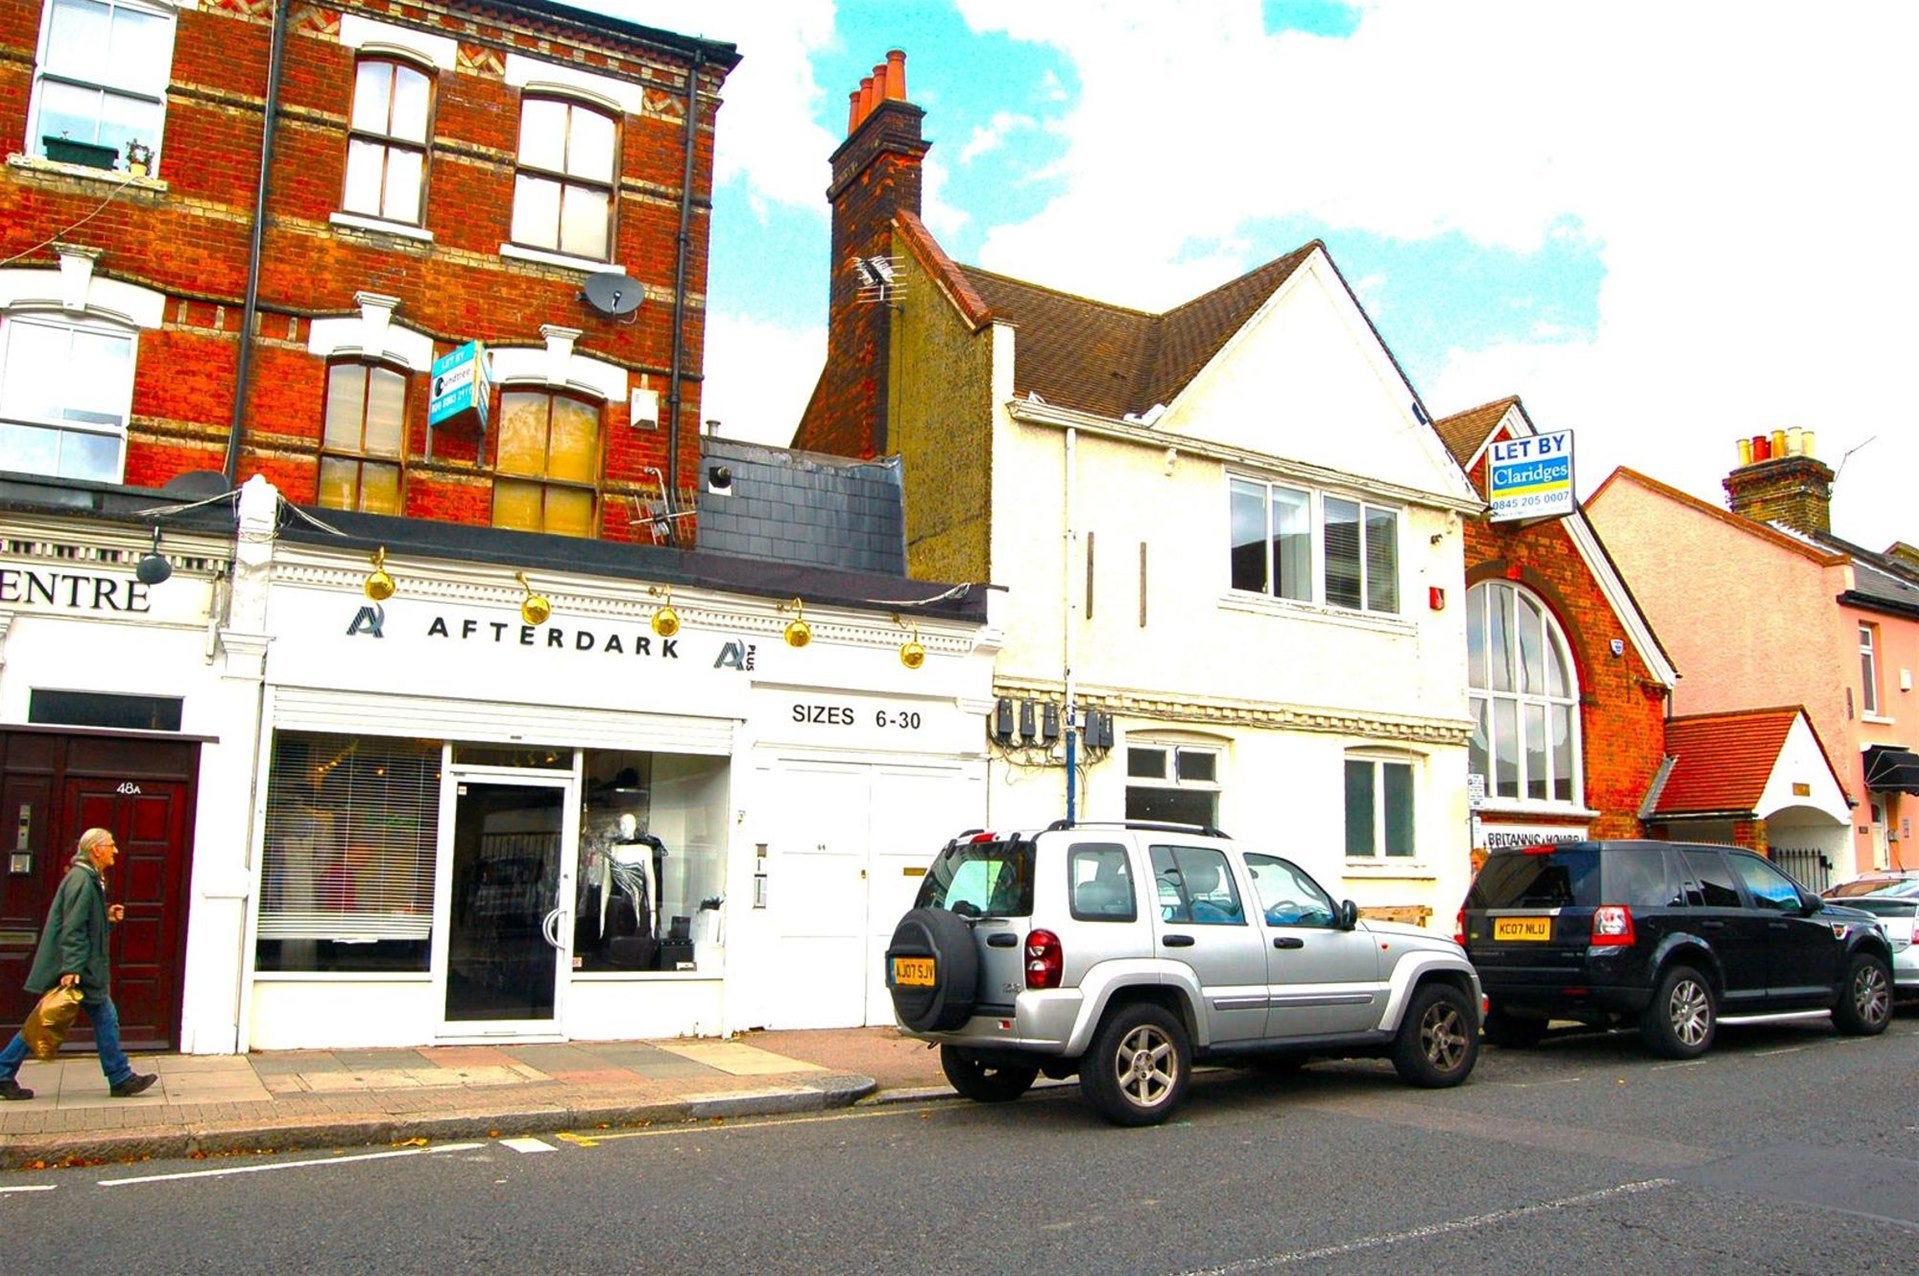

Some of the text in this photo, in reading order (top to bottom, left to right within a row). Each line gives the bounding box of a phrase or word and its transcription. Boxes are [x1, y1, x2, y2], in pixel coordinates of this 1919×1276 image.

[1494, 434, 1565, 461] LET BY
[1494, 463, 1567, 485] Claridges
[1493, 491, 1569, 511] 0845 205 0007
[427, 616, 679, 659] AFTERDARK
[746, 644, 756, 672] PLUS
[792, 704, 921, 729] SIZES 6-30
[116, 782, 141, 794] 48A
[1488, 833, 1541, 847] BRITANNIC
[1500, 923, 1545, 935] KC07 NLU
[896, 962, 934, 979] AJ07 SJV
